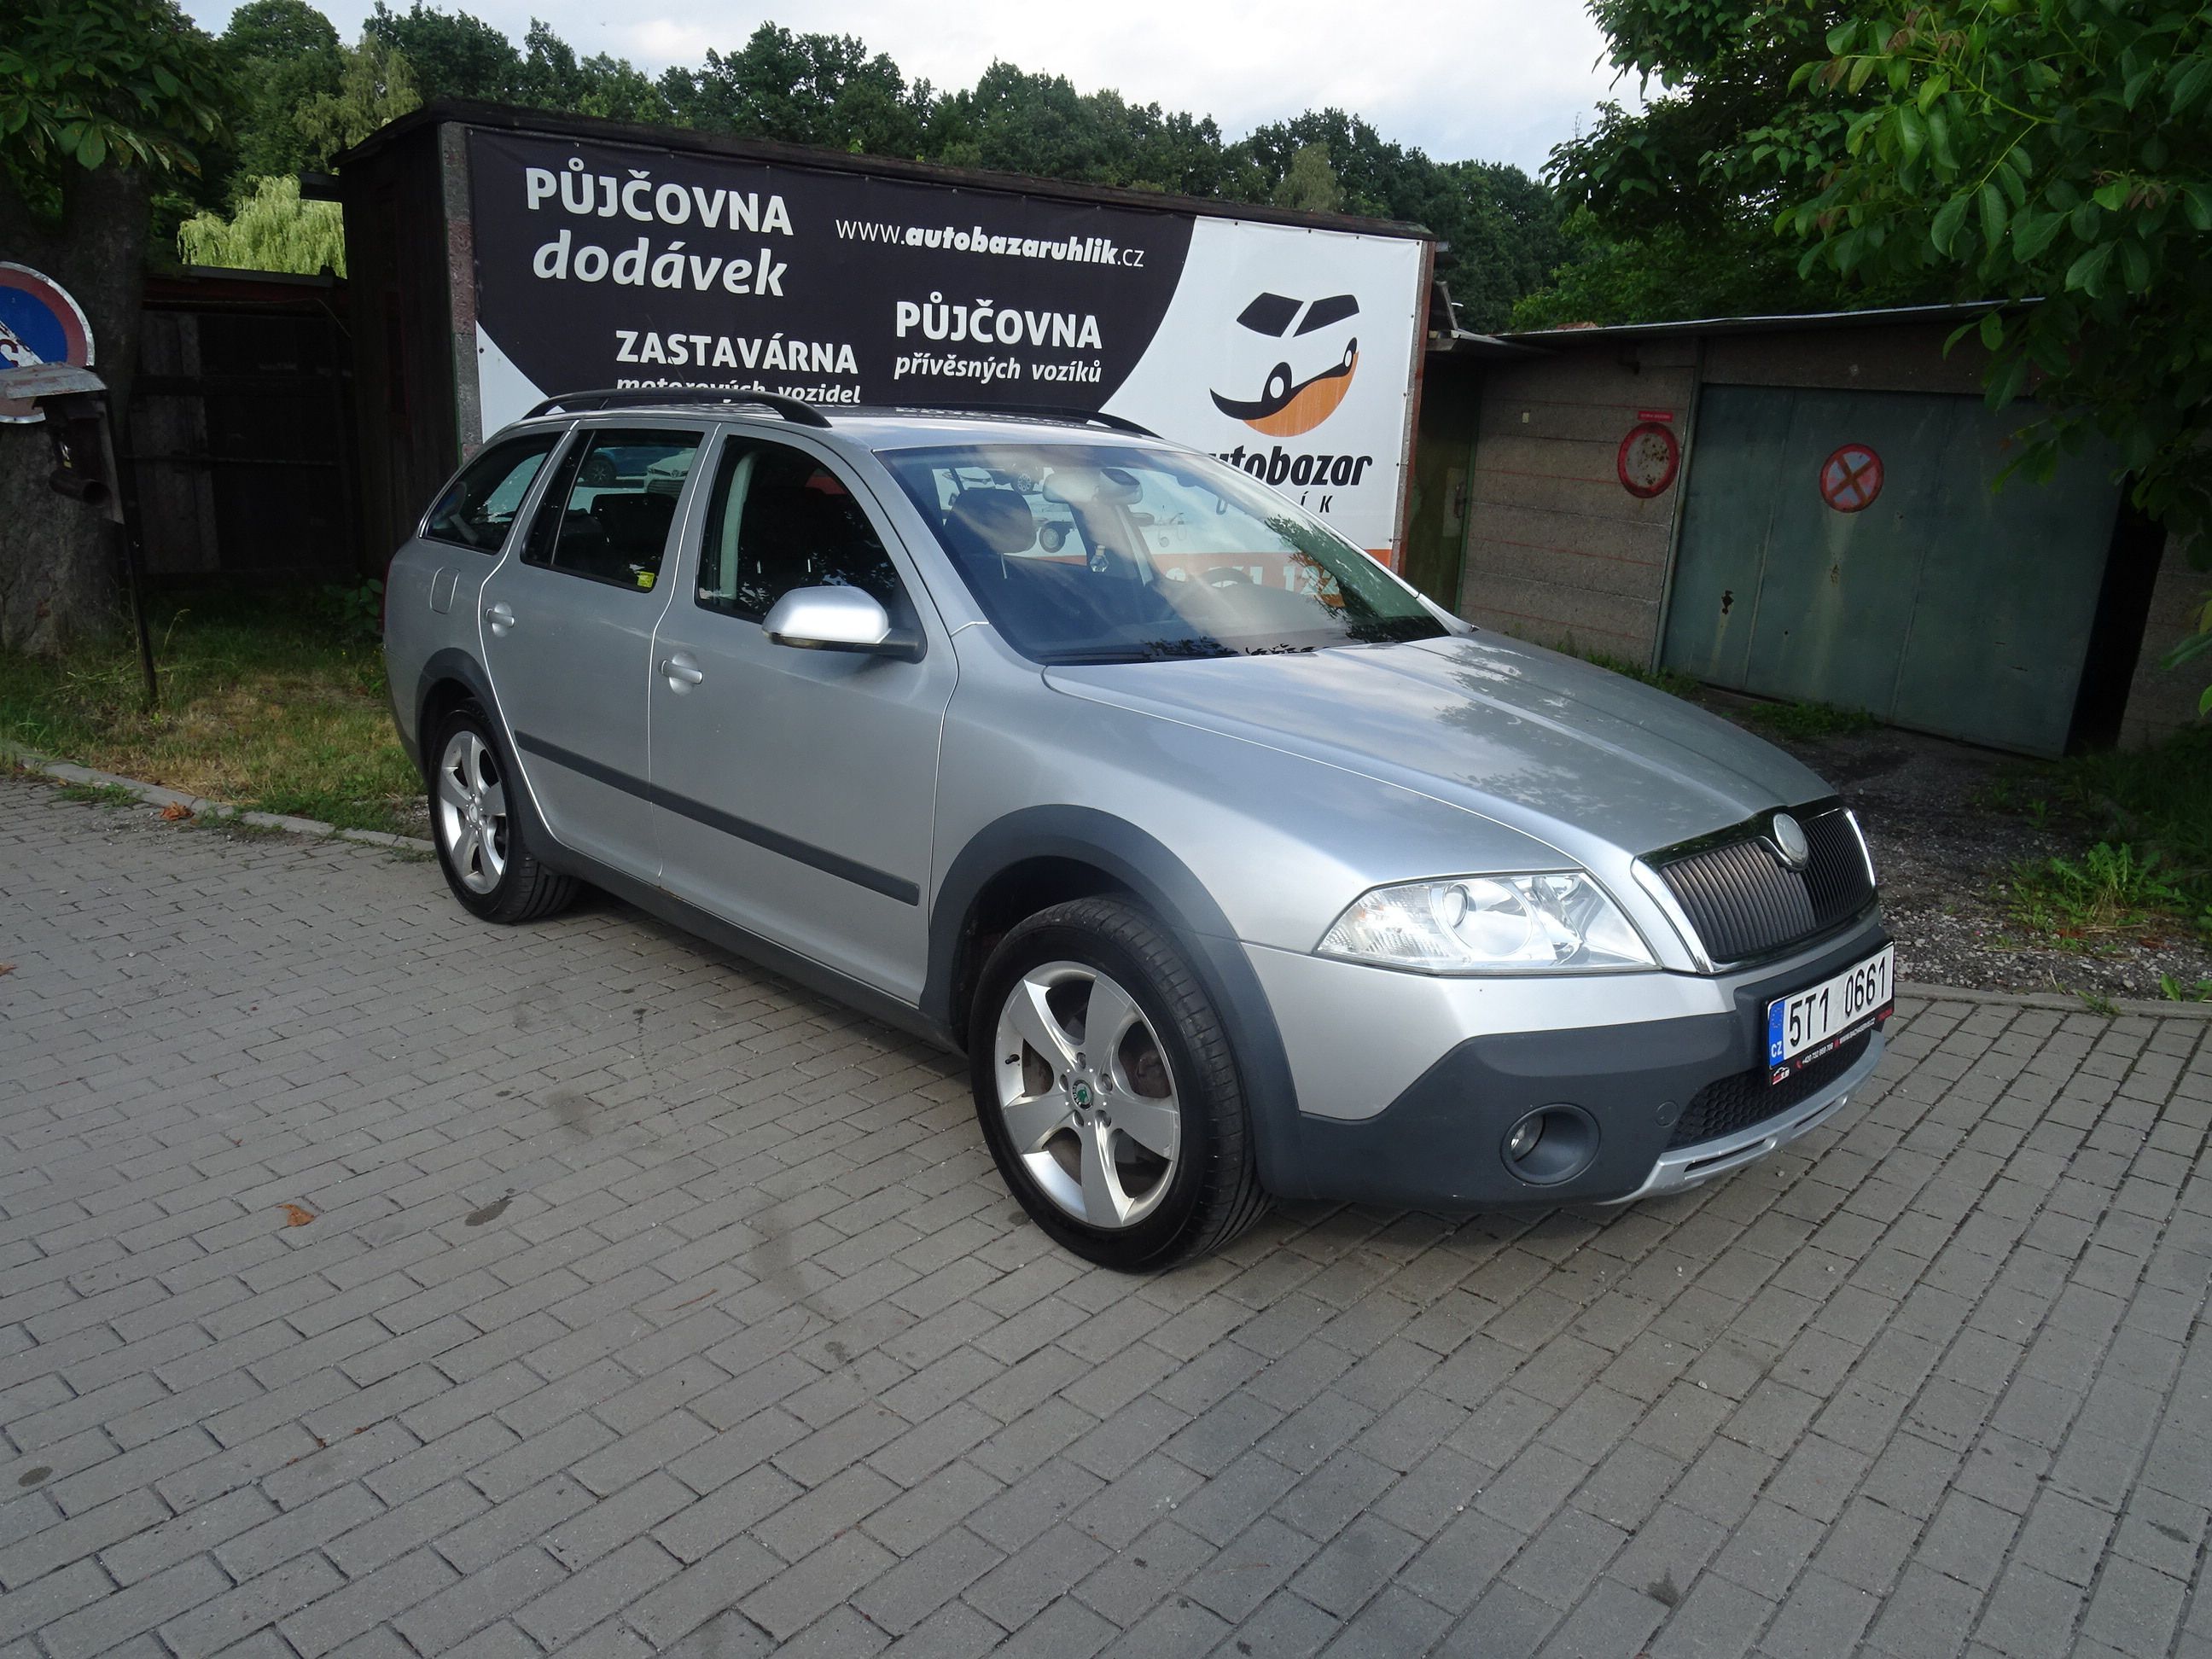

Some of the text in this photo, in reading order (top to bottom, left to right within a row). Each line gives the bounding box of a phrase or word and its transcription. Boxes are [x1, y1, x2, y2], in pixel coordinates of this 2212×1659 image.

[525, 157, 795, 236] PŮJČOVNA
[532, 229, 789, 297] dodávek
[835, 218, 1145, 267] www.autobazaruhlik.cz
[896, 291, 1103, 349] PŮJČOVNA
[614, 329, 859, 375] ZASTAVÁRNA
[894, 352, 1103, 384] přívěsných vozíků
[777, 383, 861, 404] vozidel
[1789, 987, 1830, 1048] 5T1
[1845, 955, 1886, 1019] 0661
[1771, 1040, 1783, 1058] CZ
